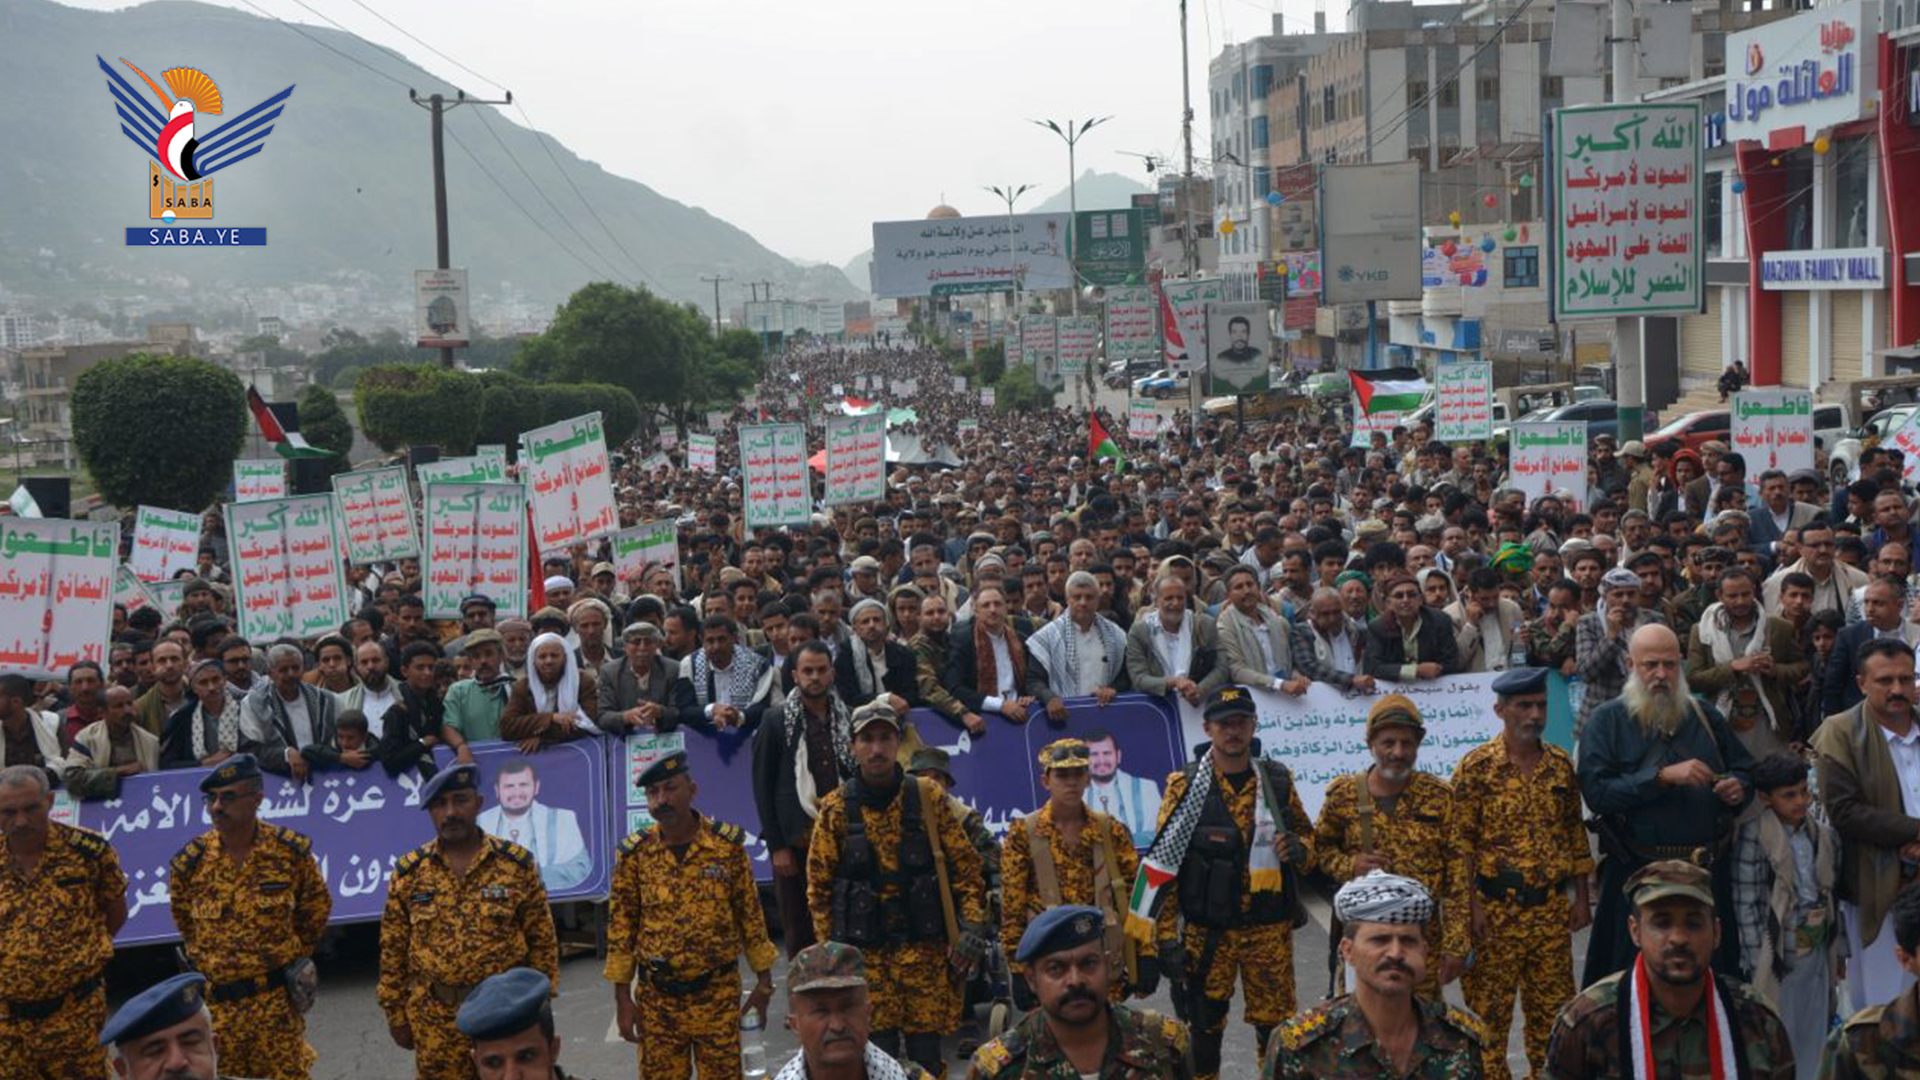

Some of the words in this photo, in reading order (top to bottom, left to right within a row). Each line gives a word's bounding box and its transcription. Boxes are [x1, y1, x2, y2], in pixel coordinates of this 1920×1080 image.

[1778, 52, 1854, 105] العائلة
[1729, 83, 1774, 122] مول
[1567, 113, 1648, 163] أكبر
[1652, 116, 1693, 149] الله
[1566, 159, 1639, 192] لأمريكا
[1644, 164, 1692, 189] الموت
[1567, 198, 1639, 229] لإسرائيل
[1644, 198, 1692, 224] الموت
[1566, 235, 1617, 262] اليهود
[1624, 234, 1650, 261] على
[1658, 232, 1692, 254] اللعنة
[1356, 270, 1388, 281] YKB
[1642, 262, 1692, 301] النصر
[1763, 260, 1801, 281] MAZAYA
[1805, 258, 1845, 281] FAMILY
[1848, 257, 1880, 280] MALL
[1567, 267, 1636, 304] للإسلام
[1735, 396, 1809, 421] قاطعوا
[527, 419, 601, 464] قاطعوا
[1514, 426, 1583, 450] قاطعوا
[1777, 426, 1810, 448] البضائع
[572, 453, 607, 484] البضائع
[1768, 451, 1777, 468] و
[487, 491, 519, 513] الله
[571, 491, 577, 510] و
[141, 509, 198, 532] قاطعوا
[295, 503, 329, 526] الله
[481, 521, 519, 540] الموت
[613, 525, 675, 558] قاطعوا
[291, 535, 331, 555] الموت
[481, 546, 519, 562] الموت
[294, 560, 334, 581] الموت
[431, 569, 463, 587] اليهود
[490, 569, 518, 584] اللعنة
[56, 573, 109, 604] البضائع
[245, 590, 279, 611] اليهود
[306, 584, 336, 600] اللعنة
[41, 608, 54, 634] و
[301, 604, 340, 634] النصر
[102, 785, 190, 841] الأمة
[323, 778, 386, 823] عزة
